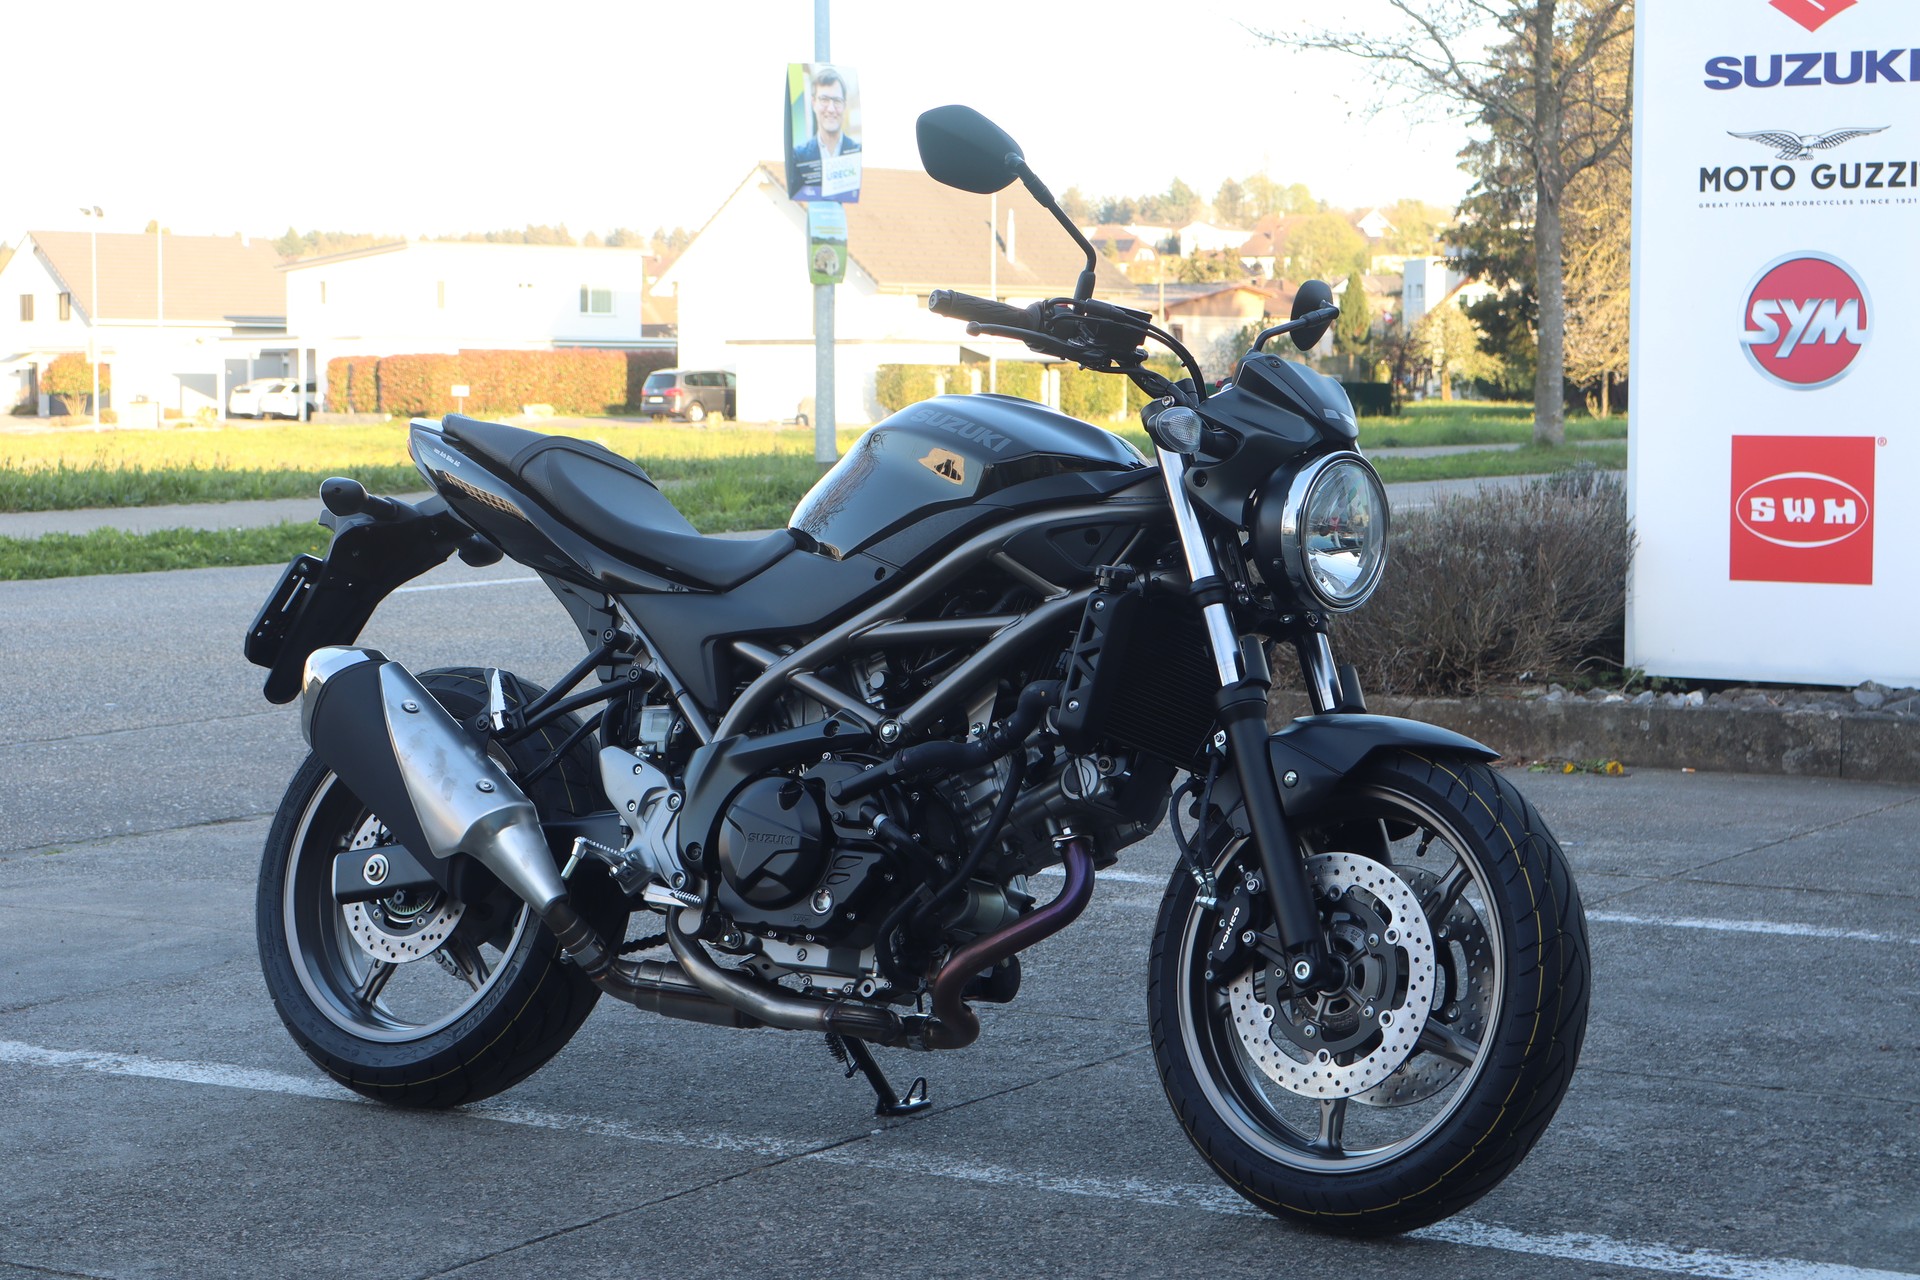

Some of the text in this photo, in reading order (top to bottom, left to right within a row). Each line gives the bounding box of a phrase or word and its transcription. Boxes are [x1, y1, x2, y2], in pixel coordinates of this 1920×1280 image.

[1704, 48, 1920, 90] SUZUKI
[1699, 161, 1917, 193] MOTO GUZZI
[1781, 199, 1854, 207] MOTORCYCLES
[1739, 298, 1867, 358] SYM
[910, 408, 1012, 452] SUZUKI
[1750, 497, 1857, 524] SWM
[747, 832, 794, 846] SUZUKI
[1218, 906, 1240, 951] TOKICO
